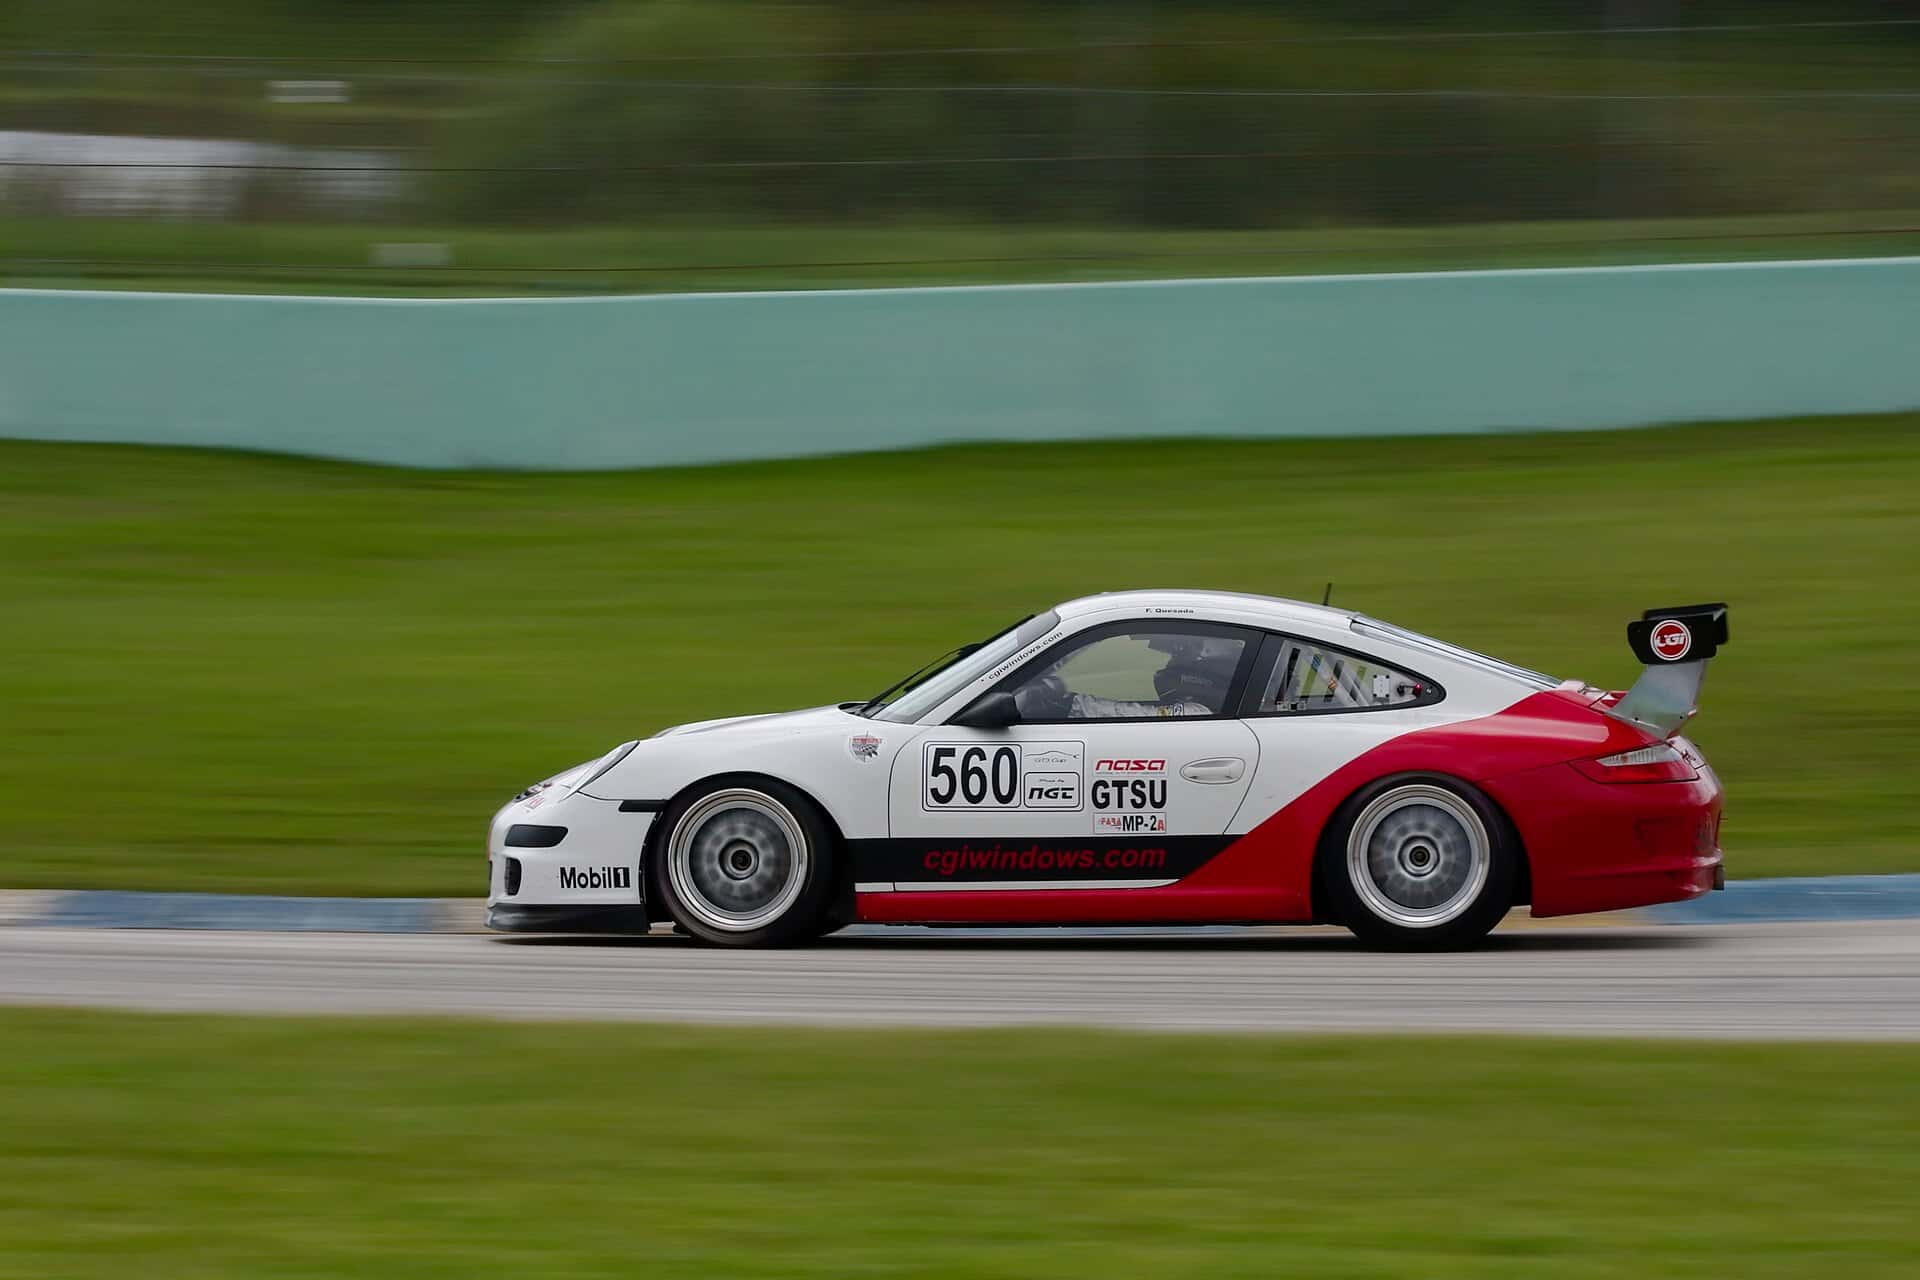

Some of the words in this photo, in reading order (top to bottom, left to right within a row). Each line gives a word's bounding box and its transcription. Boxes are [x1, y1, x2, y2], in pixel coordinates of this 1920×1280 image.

[988, 631, 1063, 680] cgiwindows.com
[930, 746, 1018, 805] 560
[1091, 779, 1168, 809] GTSU
[923, 844, 1167, 876] cgiwindows.com
